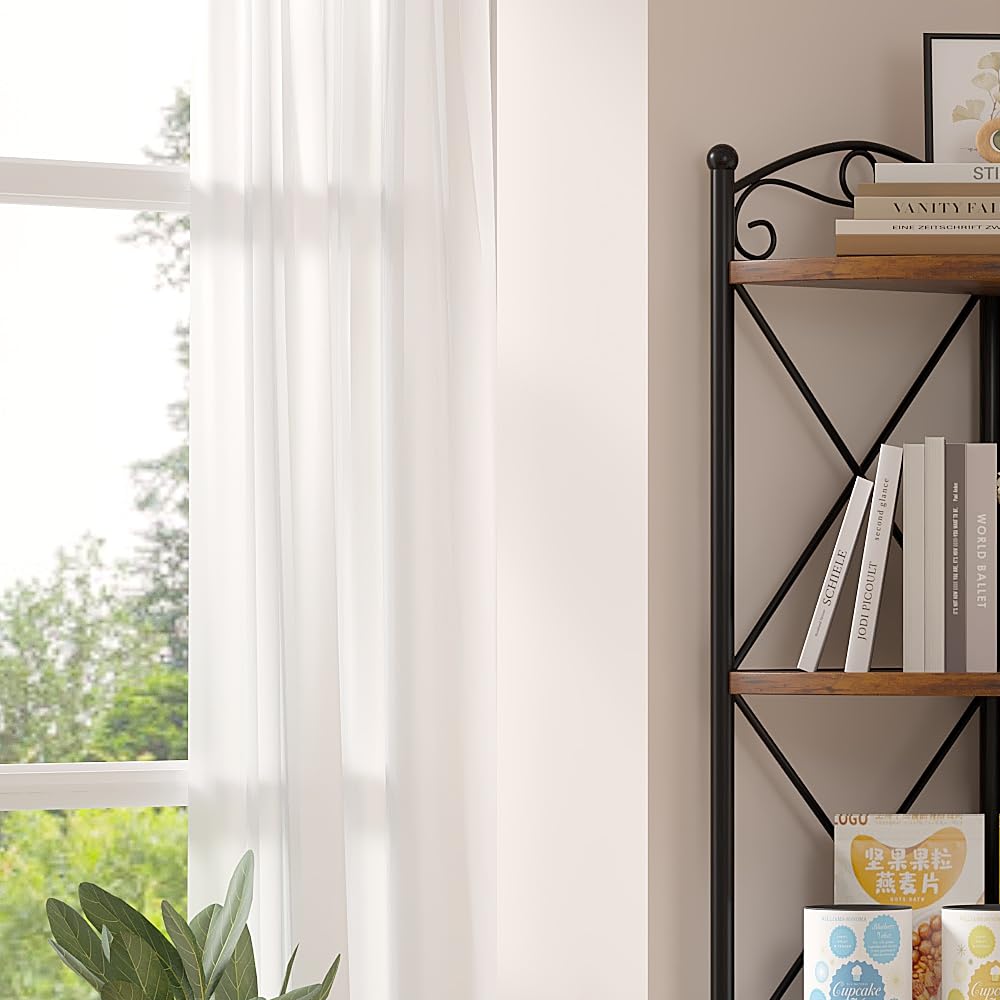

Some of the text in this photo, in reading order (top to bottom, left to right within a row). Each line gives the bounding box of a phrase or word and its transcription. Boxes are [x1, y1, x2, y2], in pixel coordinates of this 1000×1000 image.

[893, 202, 960, 214] VANITY
[857, 477, 890, 641] JODI PICOULT second glance
[977, 513, 988, 609] WORLD BALLET
[822, 549, 848, 607] SCHIELE
[834, 815, 869, 826] OGO
[864, 847, 952, 872] 坚果果粒
[875, 871, 939, 895] 燕麦片
[832, 981, 882, 1000] Cupcake
